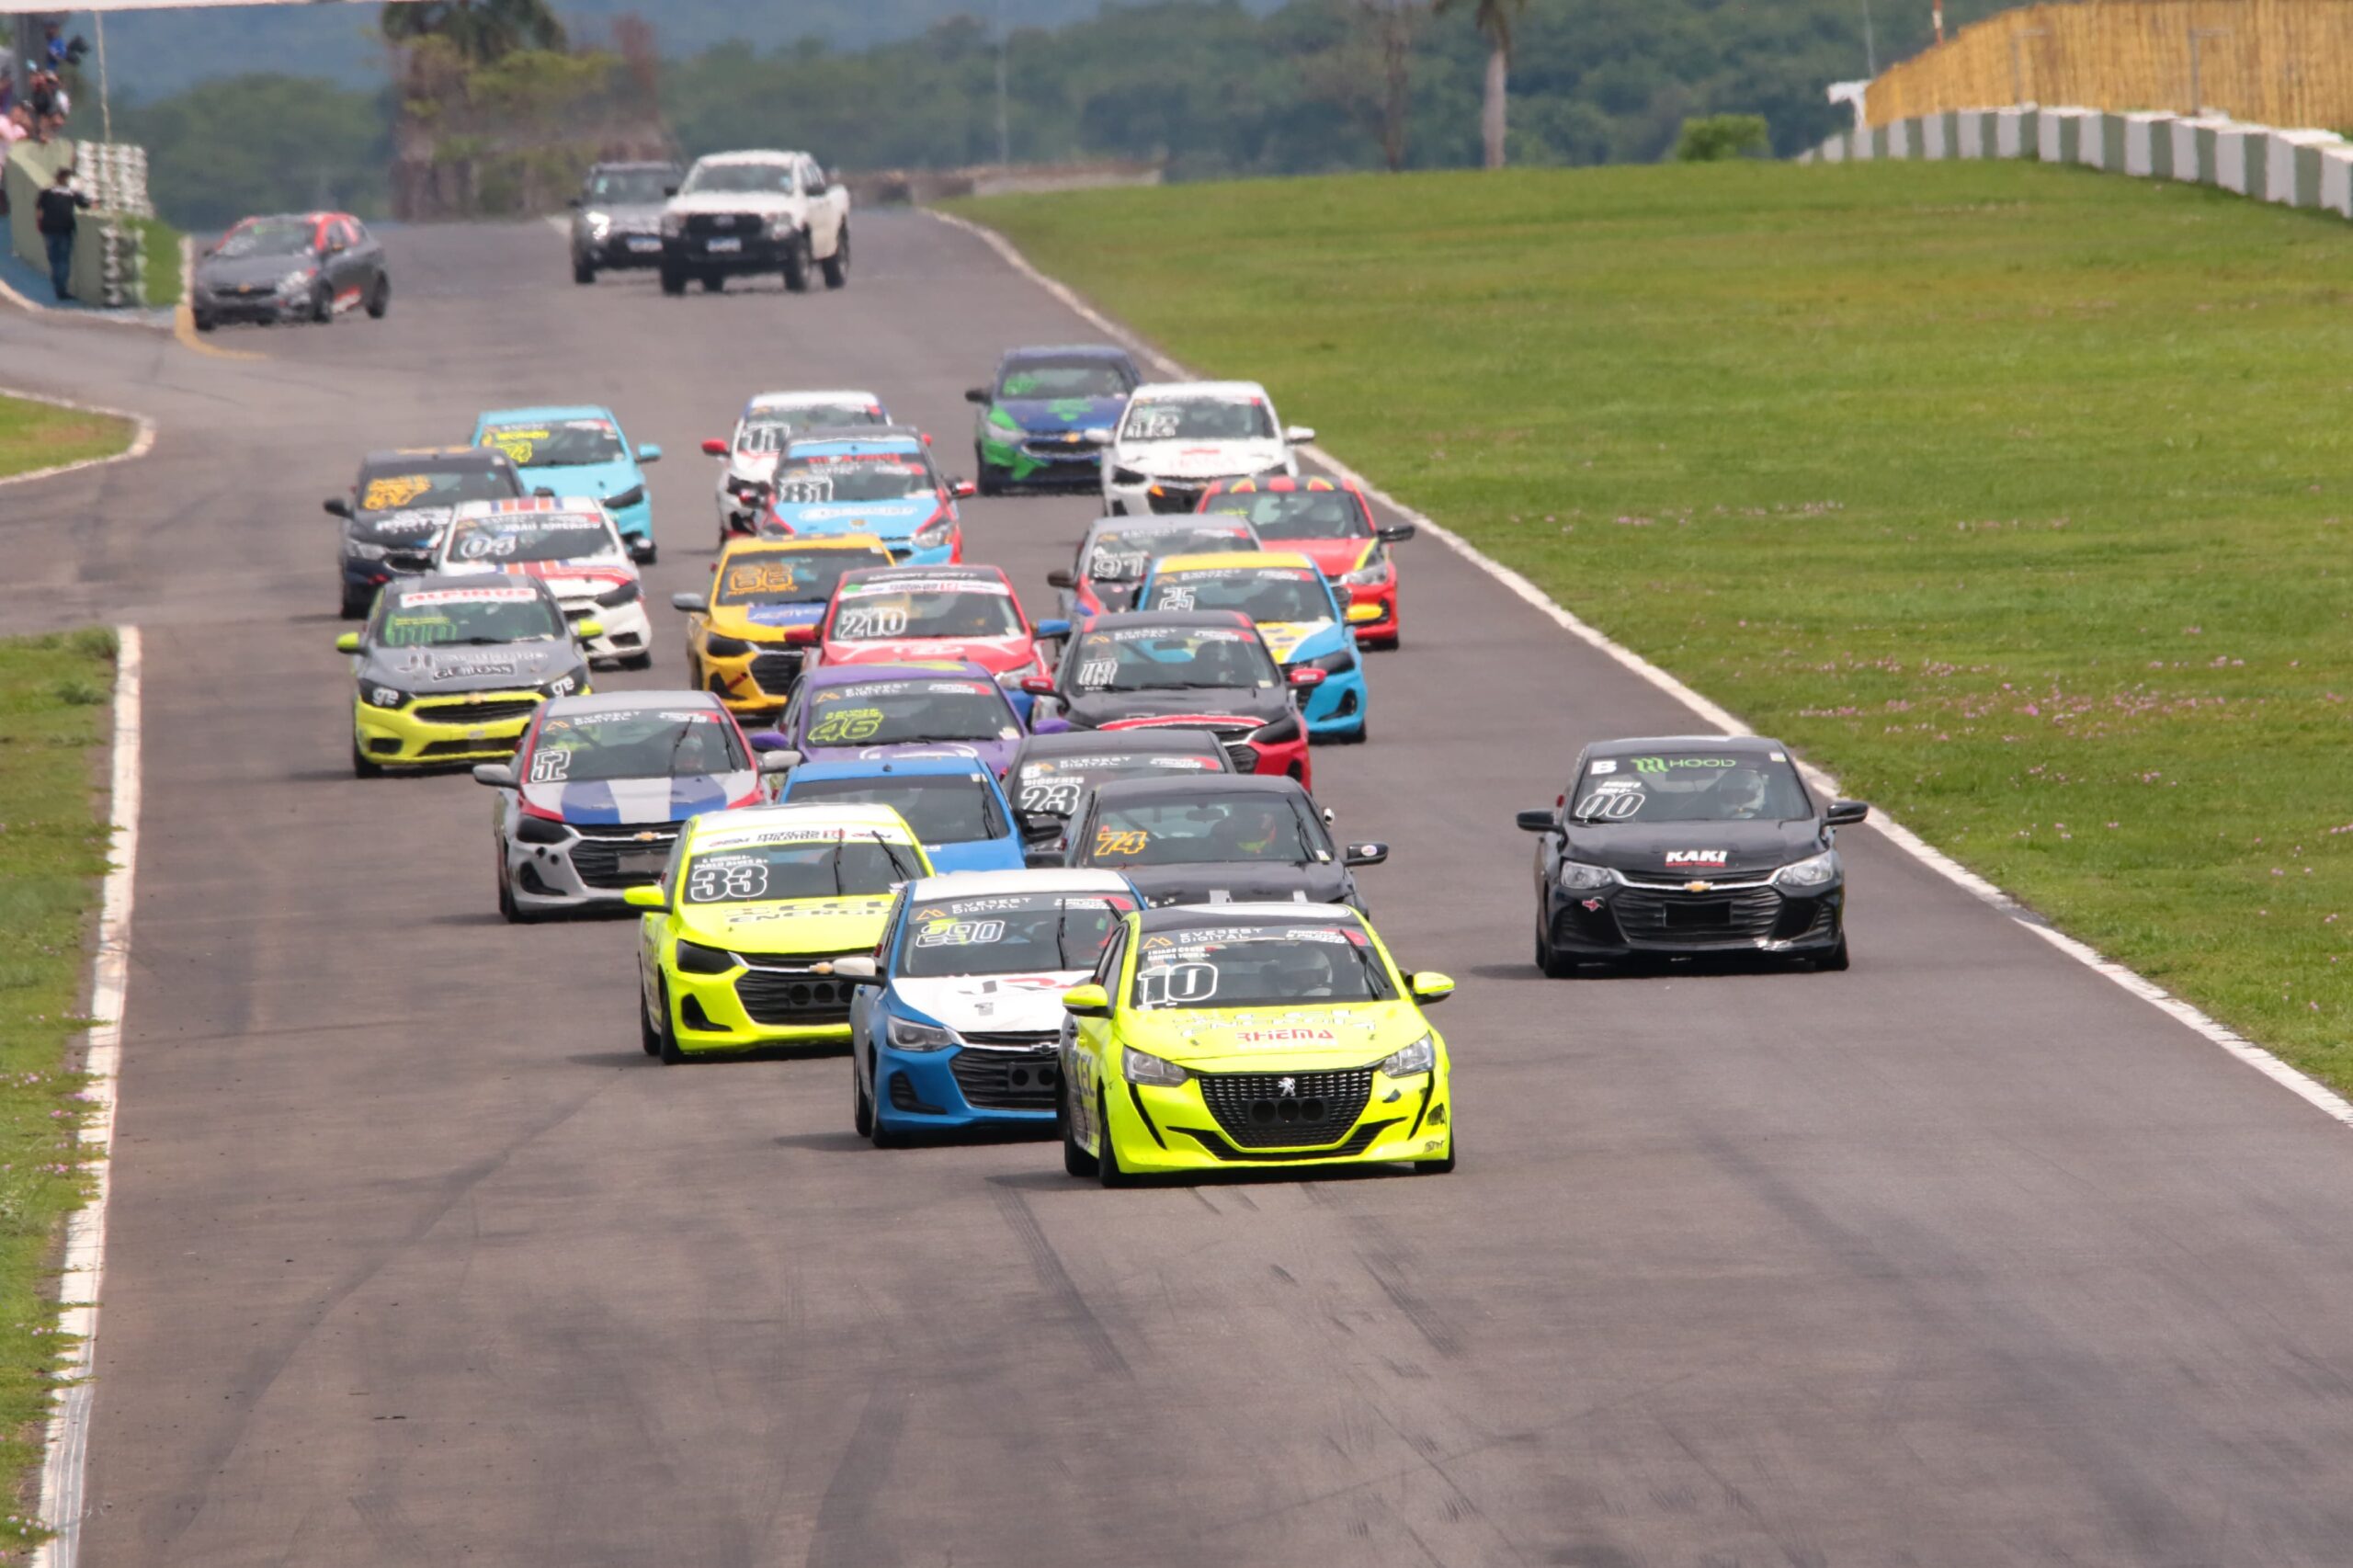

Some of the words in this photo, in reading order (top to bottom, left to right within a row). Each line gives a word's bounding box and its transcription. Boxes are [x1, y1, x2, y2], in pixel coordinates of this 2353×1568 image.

[840, 608, 907, 640] 210
[807, 712, 884, 741] 46
[1590, 760, 1617, 775] B
[1668, 758, 1736, 768] HOOD
[1020, 784, 1081, 815] 23
[1094, 831, 1149, 856] 74
[1665, 849, 1728, 863] KAKI
[690, 864, 768, 902] 33
[951, 897, 1032, 910] EVEREST
[952, 903, 1020, 915] DIGITAL
[915, 920, 1006, 948] 290
[1179, 927, 1264, 938] EVEREST
[1180, 933, 1250, 944] DIGITAL
[1136, 962, 1220, 1006] 10
